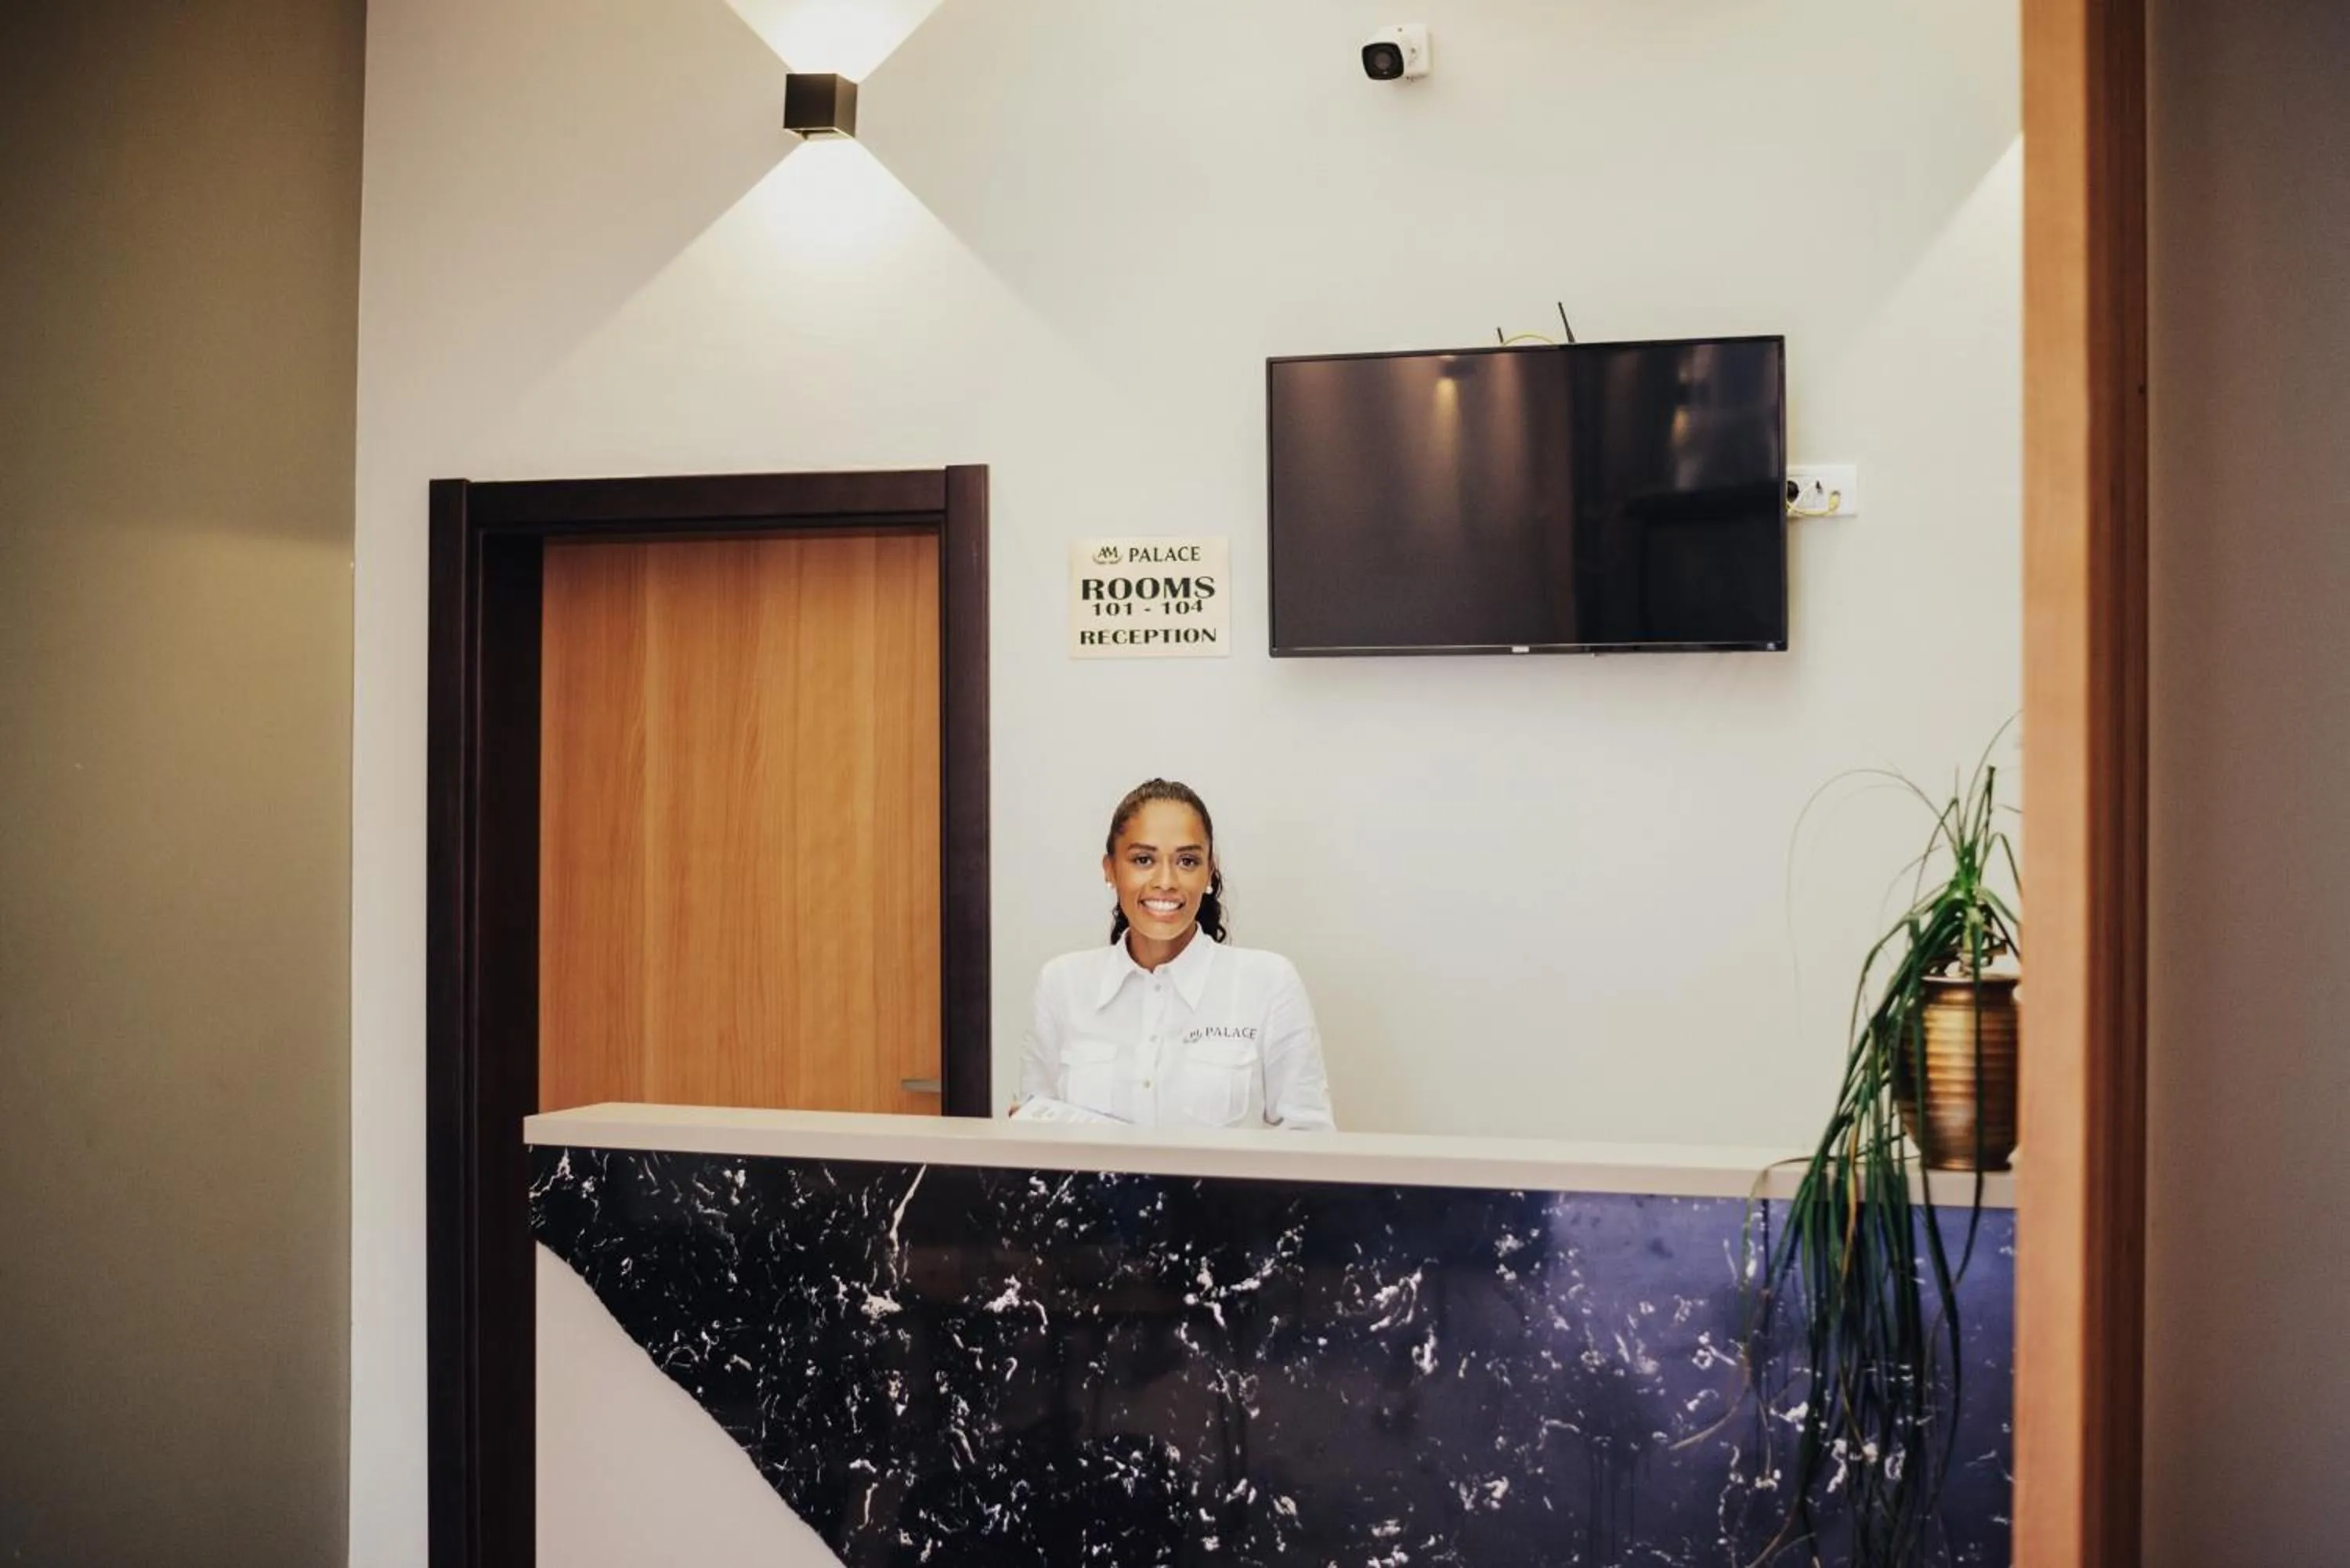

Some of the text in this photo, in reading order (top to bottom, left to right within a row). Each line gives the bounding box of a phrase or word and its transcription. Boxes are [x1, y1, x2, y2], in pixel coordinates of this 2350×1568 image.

[1129, 546, 1201, 562] PALACE
[1081, 576, 1217, 601] ROOMS
[1092, 602, 1133, 616] 101
[1161, 599, 1204, 615] 104
[1080, 627, 1217, 645] RECEPTION
[1206, 1027, 1258, 1039] PALACE
